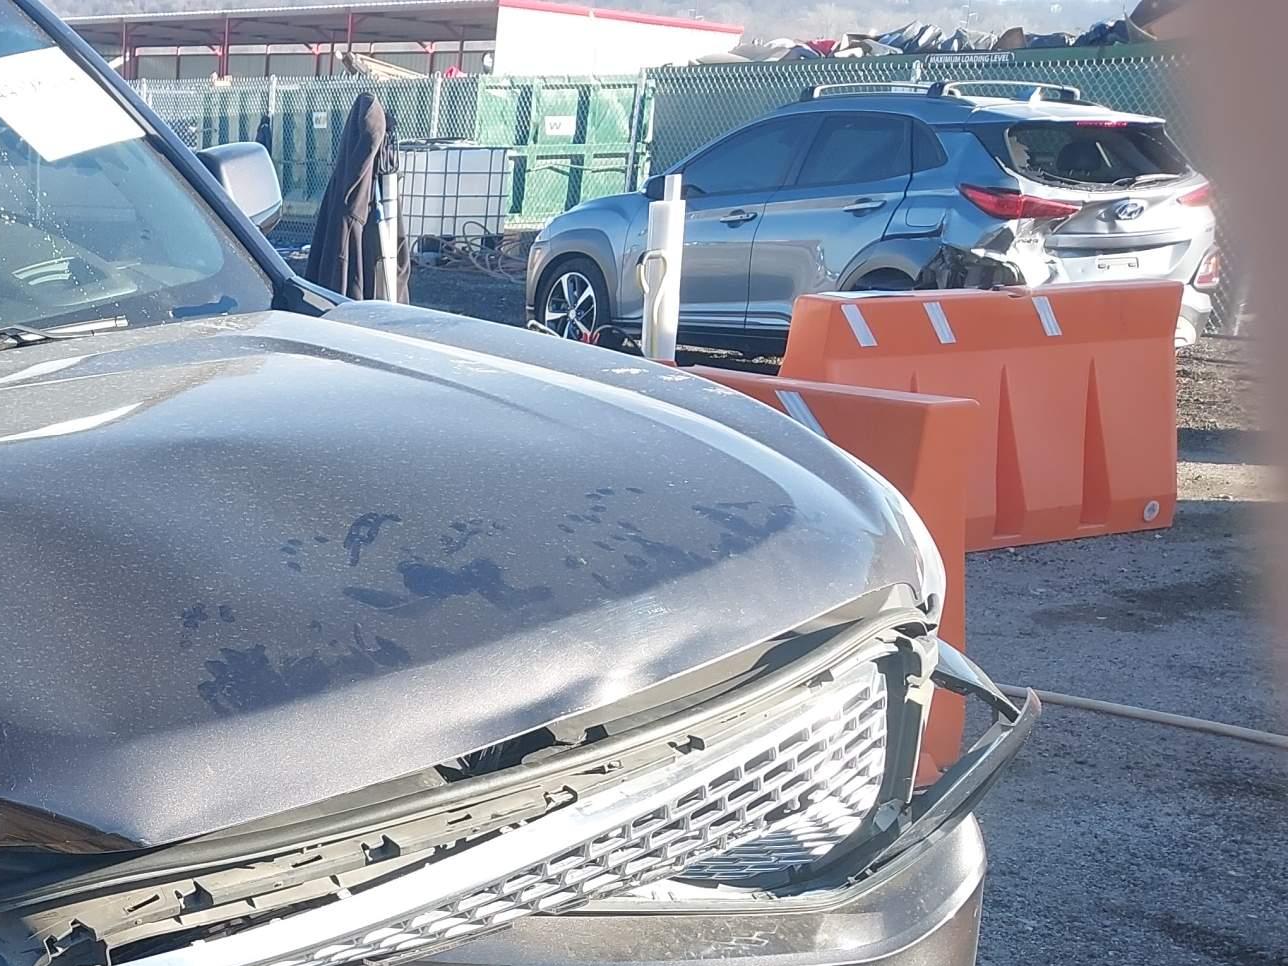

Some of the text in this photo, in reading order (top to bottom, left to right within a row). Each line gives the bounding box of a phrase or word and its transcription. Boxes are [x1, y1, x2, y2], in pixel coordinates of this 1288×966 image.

[929, 53, 1010, 63] MAXIMUM LOADING LEVEL
